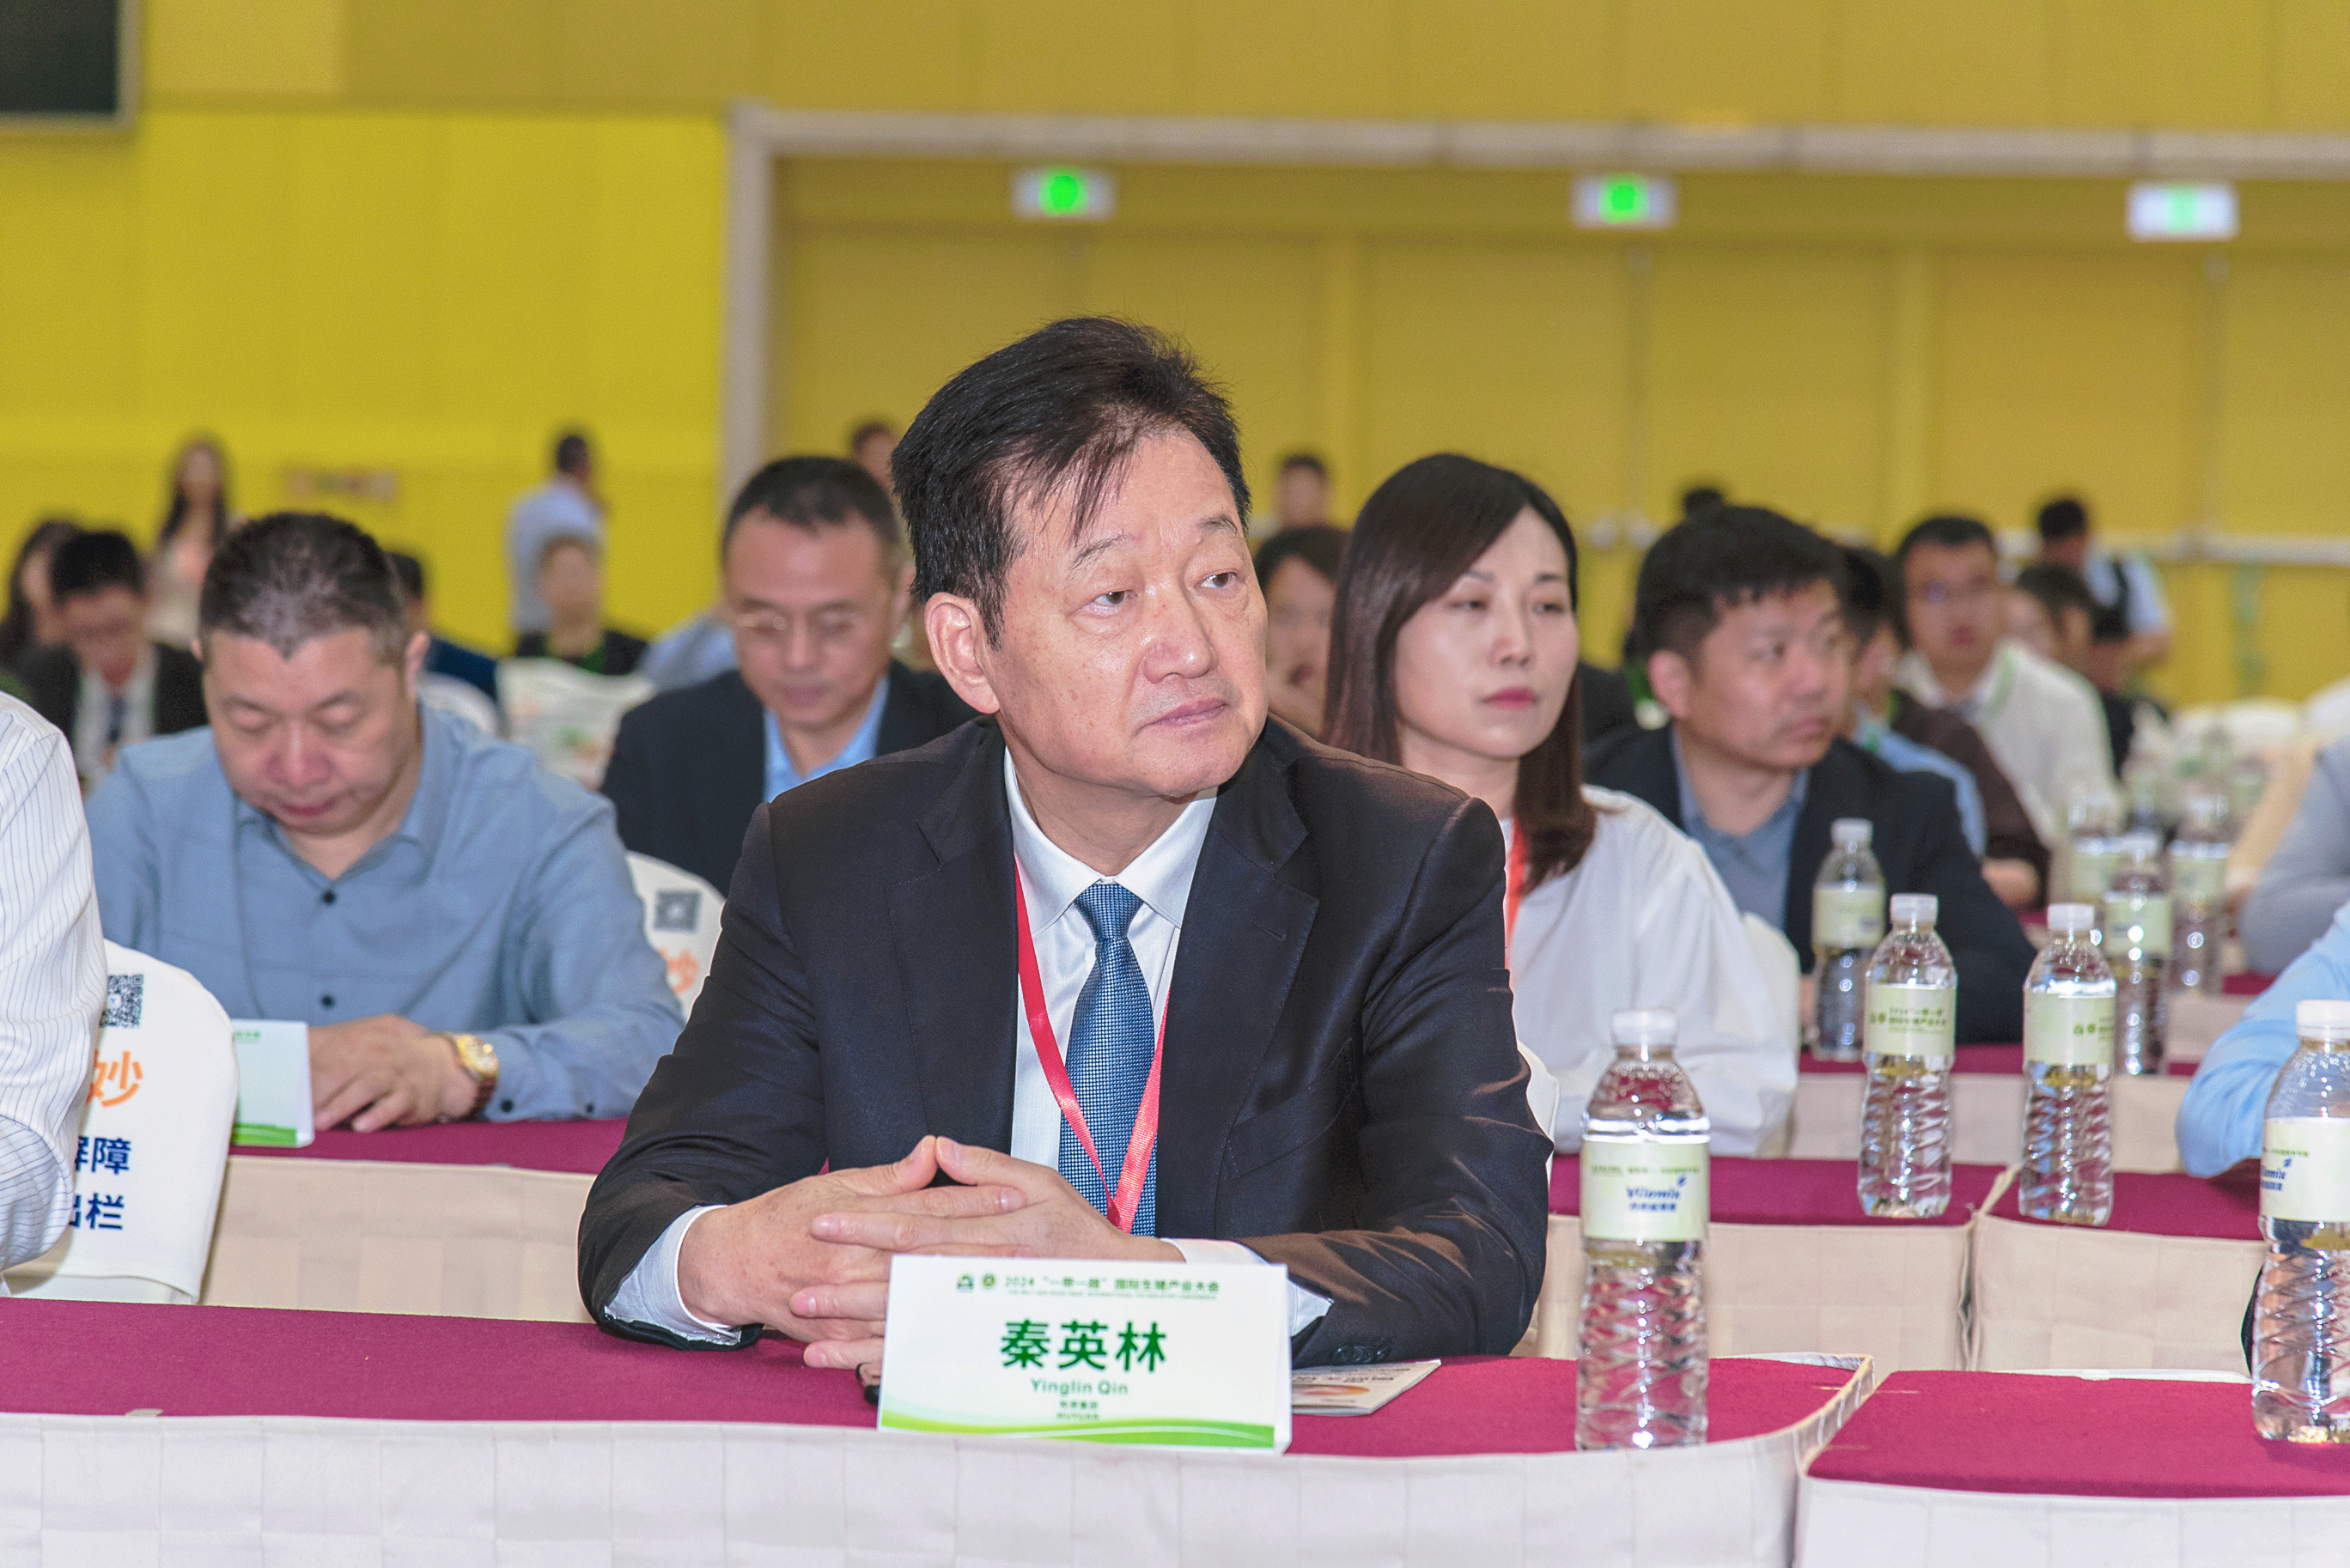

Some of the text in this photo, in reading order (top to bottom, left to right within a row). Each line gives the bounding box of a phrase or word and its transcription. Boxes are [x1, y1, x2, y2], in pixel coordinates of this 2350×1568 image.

[1001, 1319, 1166, 1372] 秦英林
[1031, 1377, 1129, 1395] Yinglin Qin
